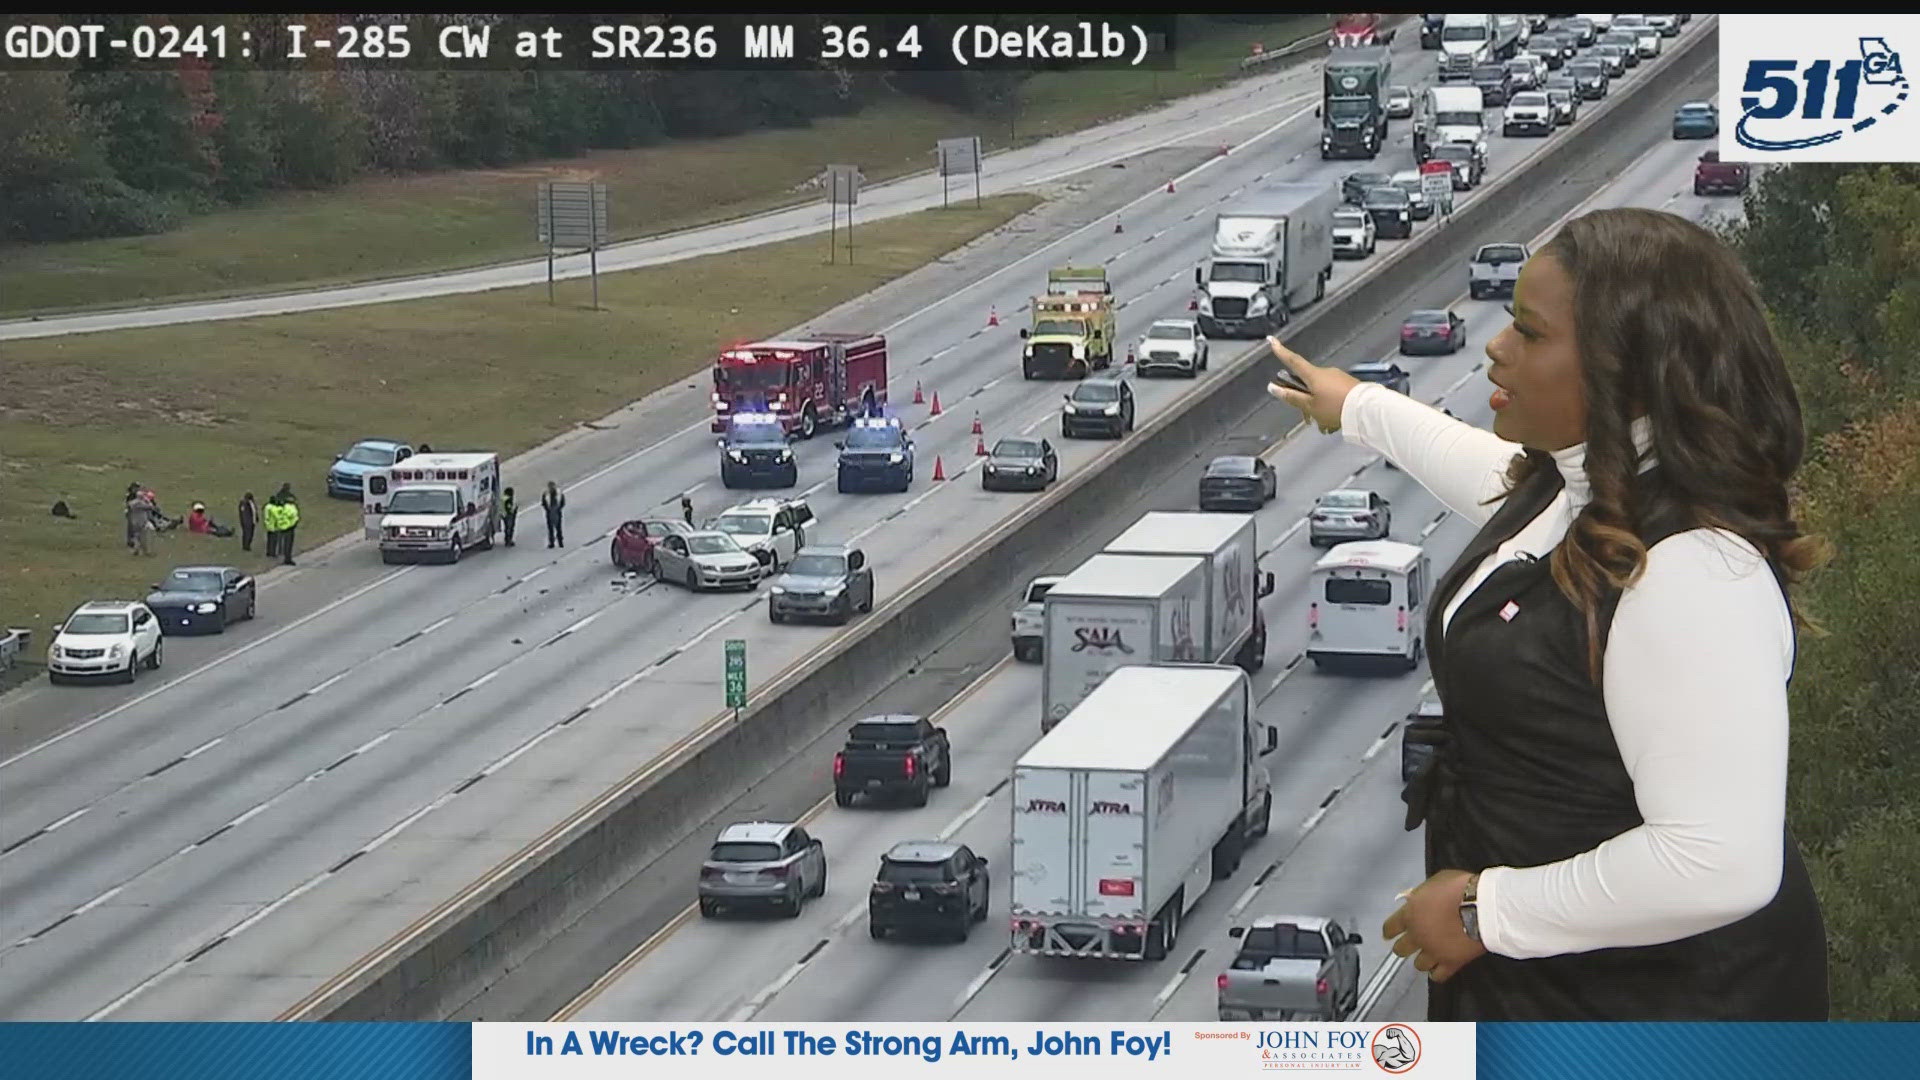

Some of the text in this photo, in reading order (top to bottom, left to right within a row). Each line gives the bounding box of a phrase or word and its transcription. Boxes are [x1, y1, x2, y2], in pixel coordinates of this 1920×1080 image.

[729, 681, 743, 692] 36
[1025, 799, 1067, 813] XTRA
[1088, 801, 1131, 815] XTRA
